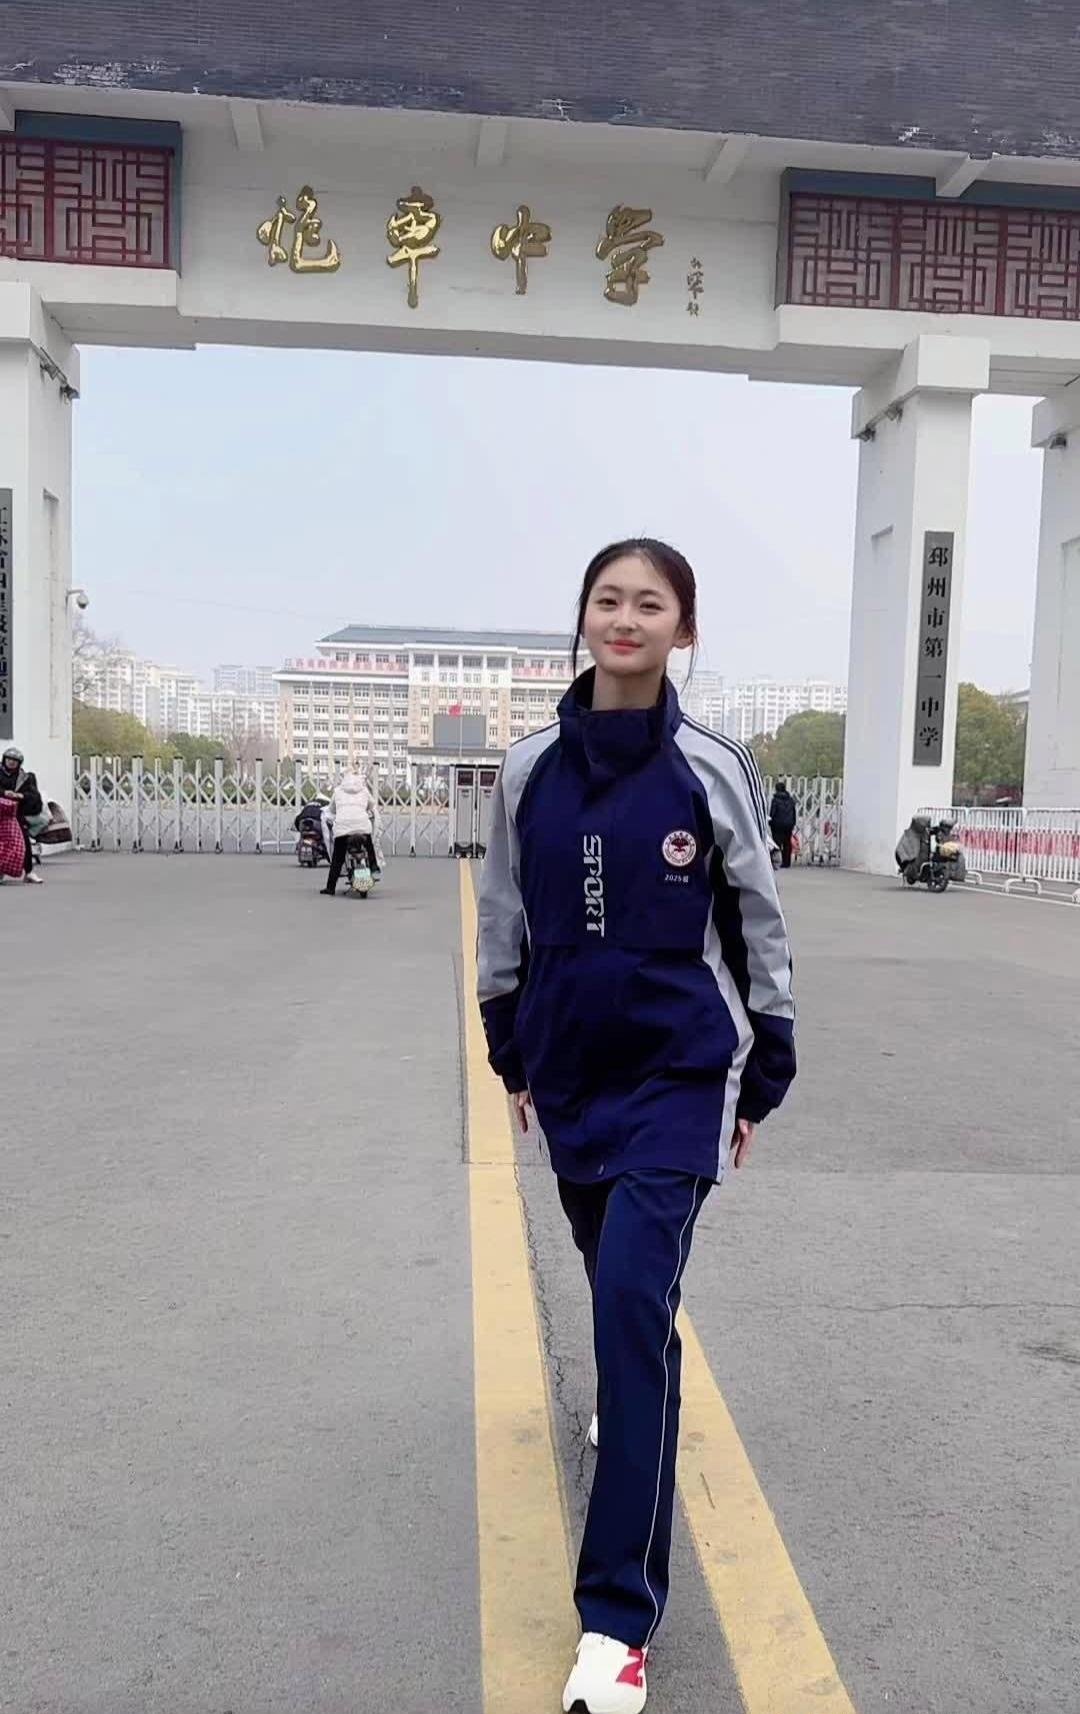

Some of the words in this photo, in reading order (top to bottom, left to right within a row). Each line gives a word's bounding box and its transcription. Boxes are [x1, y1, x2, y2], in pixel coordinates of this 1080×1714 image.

[919, 546, 948, 748] 邳州市第一中学
[583, 834, 605, 938] SPORT
